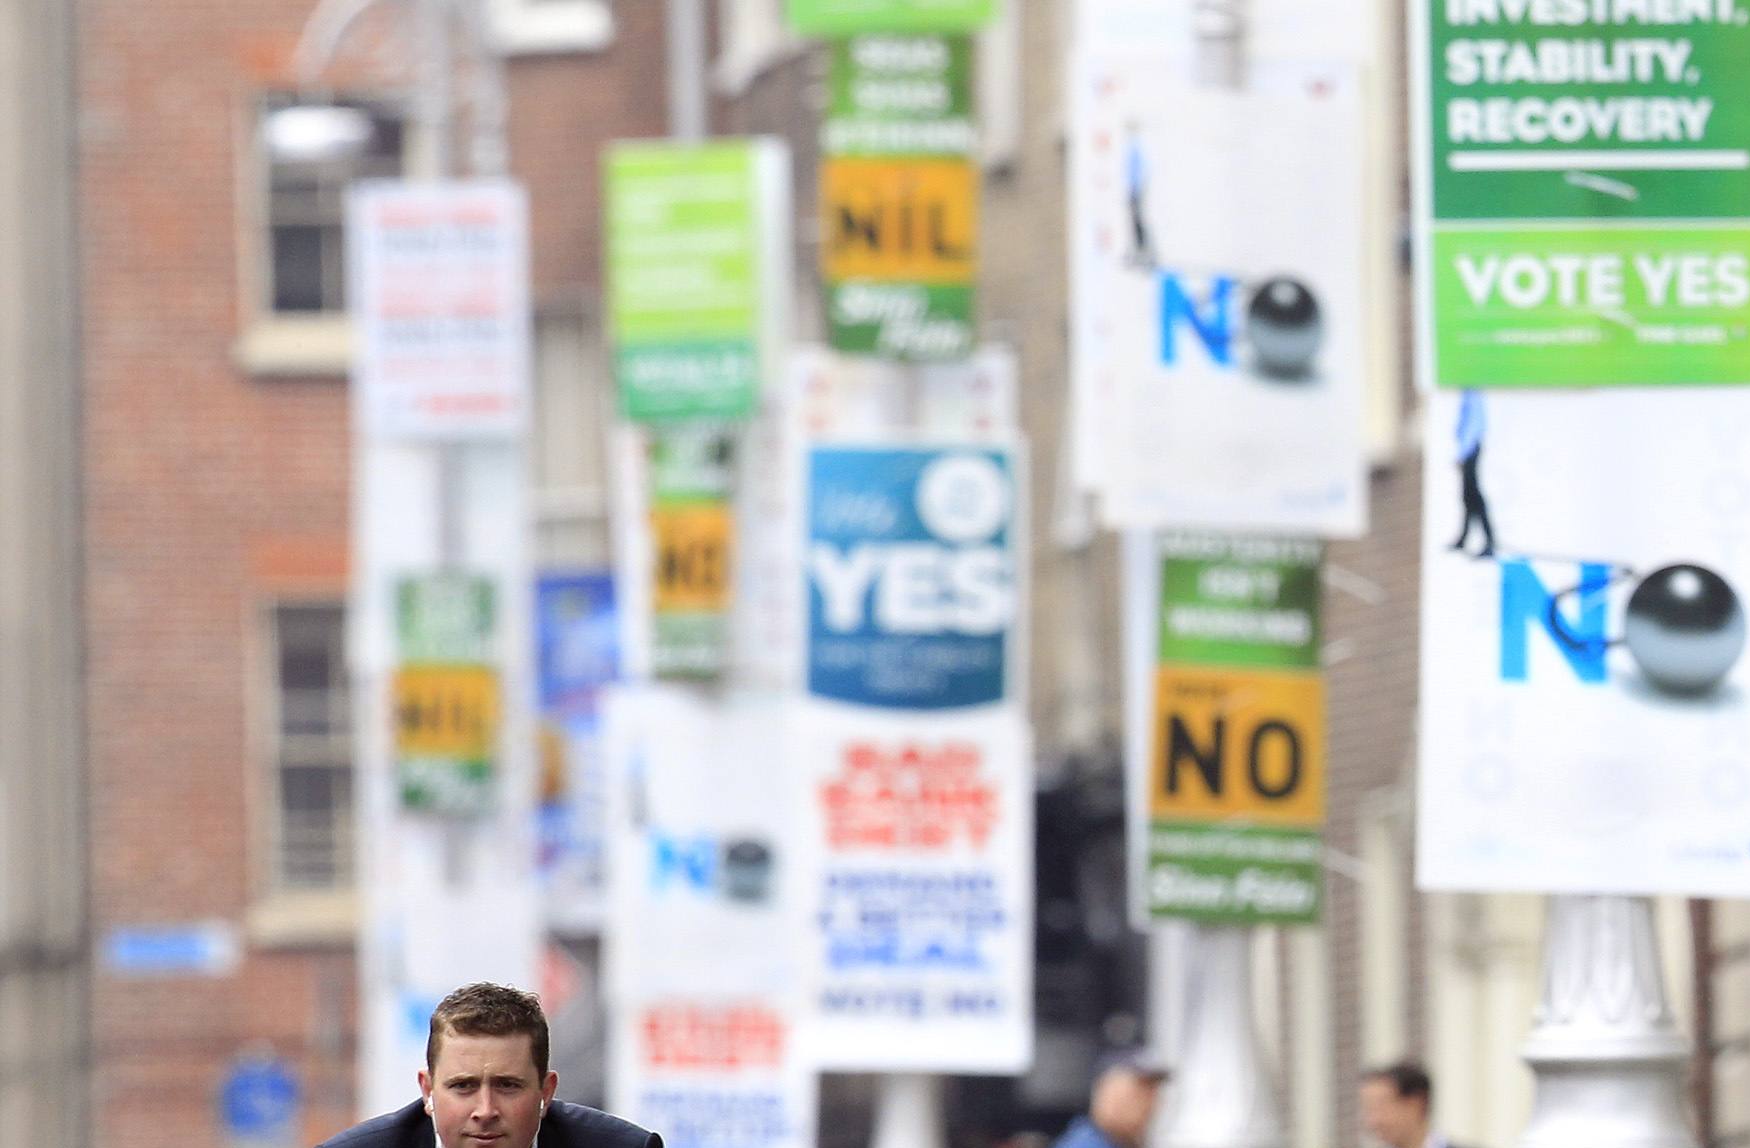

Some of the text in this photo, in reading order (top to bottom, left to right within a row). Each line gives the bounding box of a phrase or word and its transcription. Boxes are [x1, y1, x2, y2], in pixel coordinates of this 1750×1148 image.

[1445, 0, 1750, 26] INVESTMENT.
[1445, 38, 1701, 85] STABILITY.
[1447, 97, 1713, 143] RECOVERY
[1454, 253, 1625, 309] VOTE
[811, 542, 1018, 636] YES
[1164, 712, 1304, 800] NO
